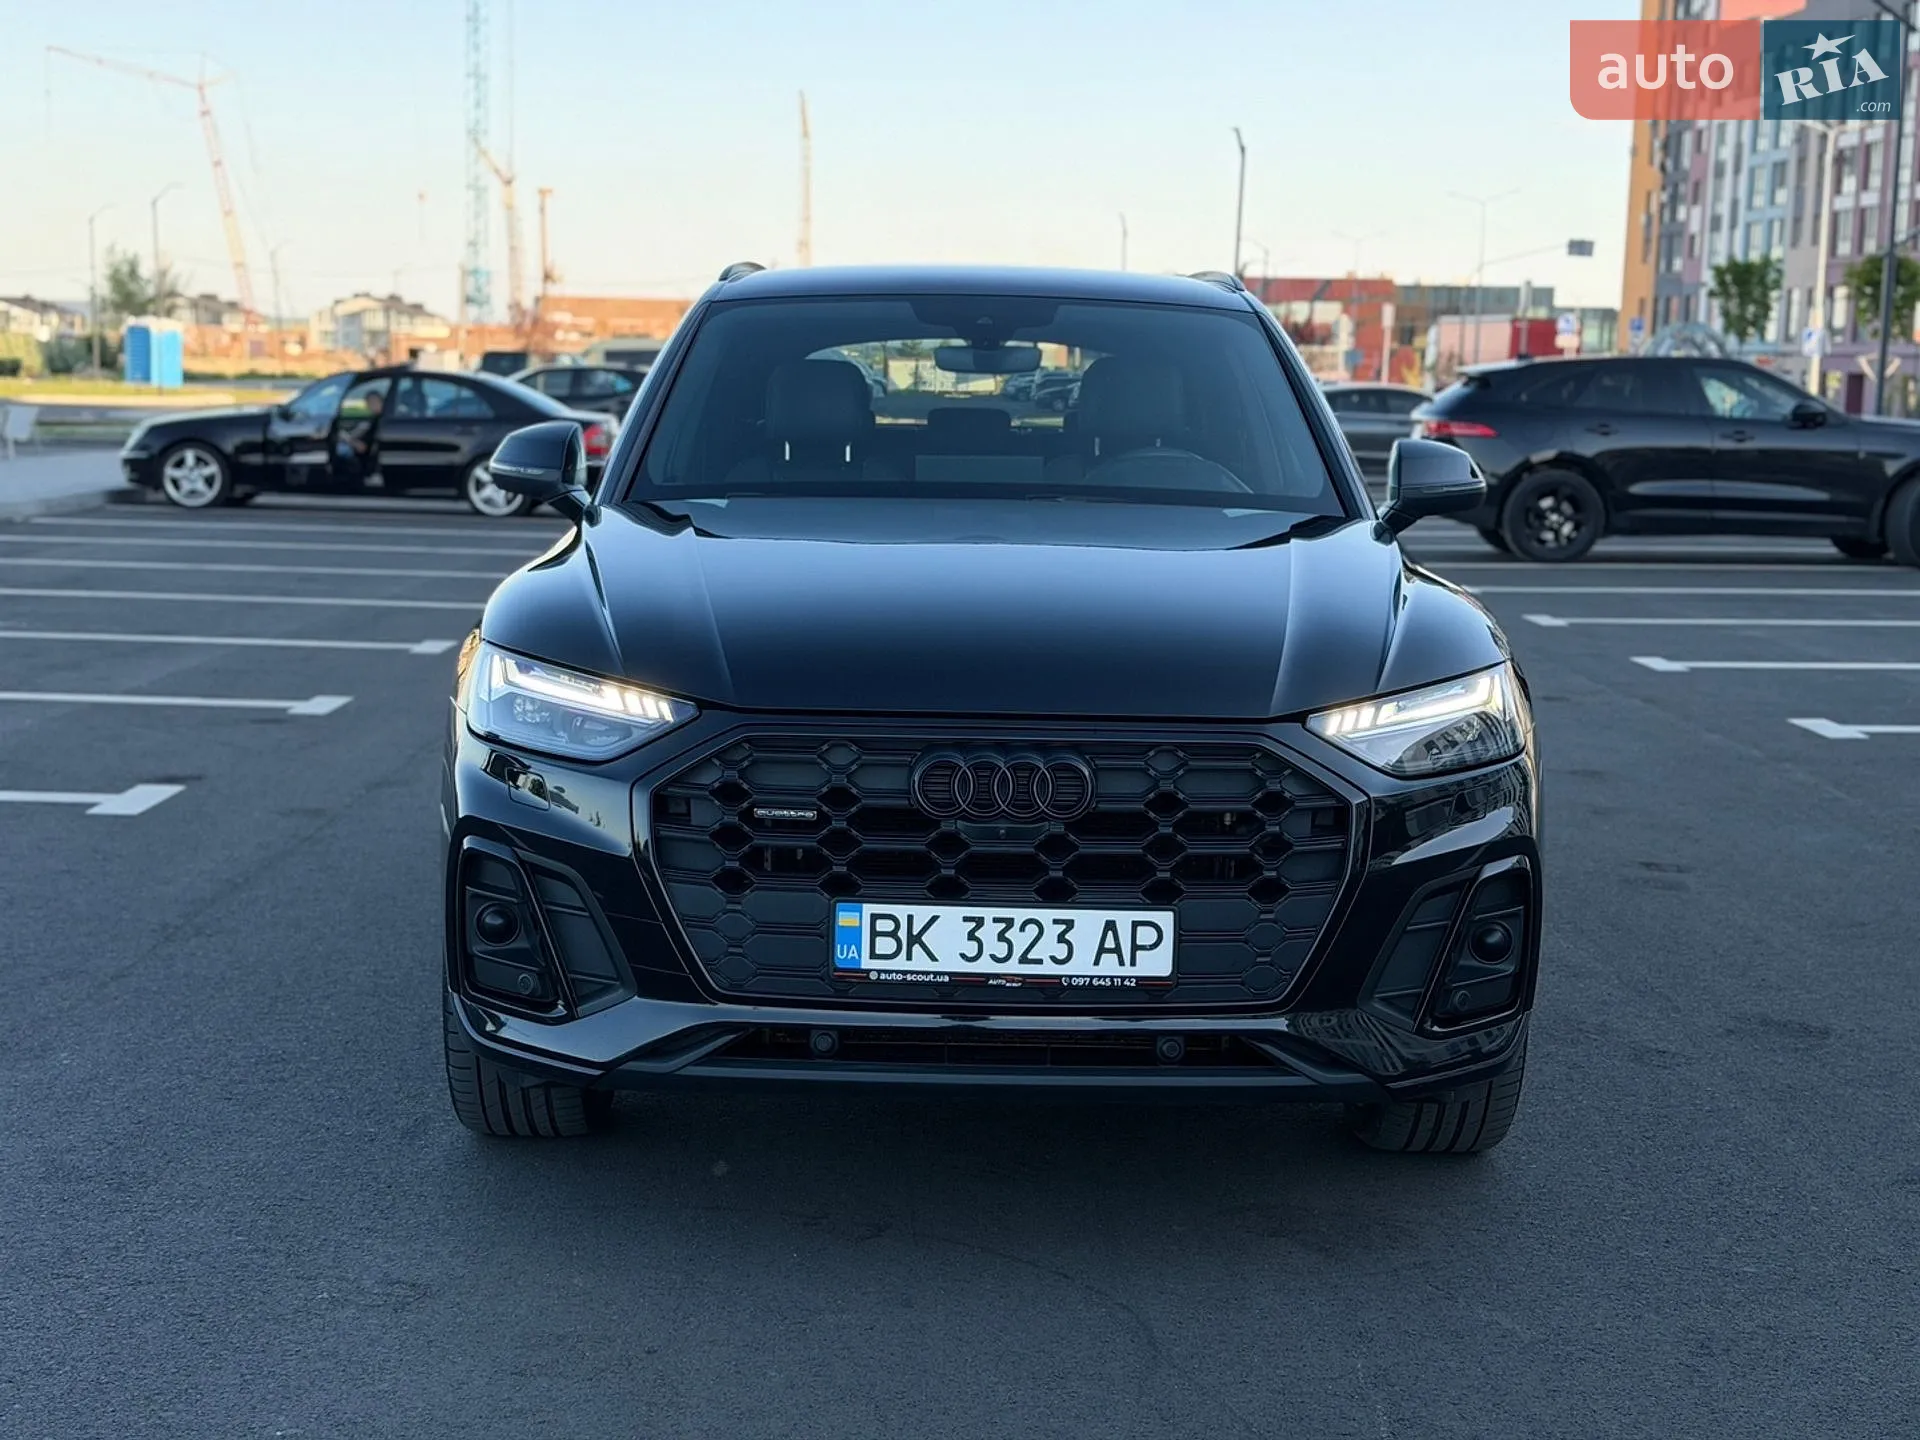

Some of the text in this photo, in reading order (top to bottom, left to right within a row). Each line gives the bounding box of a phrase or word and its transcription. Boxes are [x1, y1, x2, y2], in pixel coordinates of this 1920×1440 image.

[869, 912, 1164, 968] BK 3323 AP
[837, 943, 859, 960] UA
[879, 972, 950, 983] auto-scout.ua
[1071, 977, 1137, 987] 097 645 11 42
